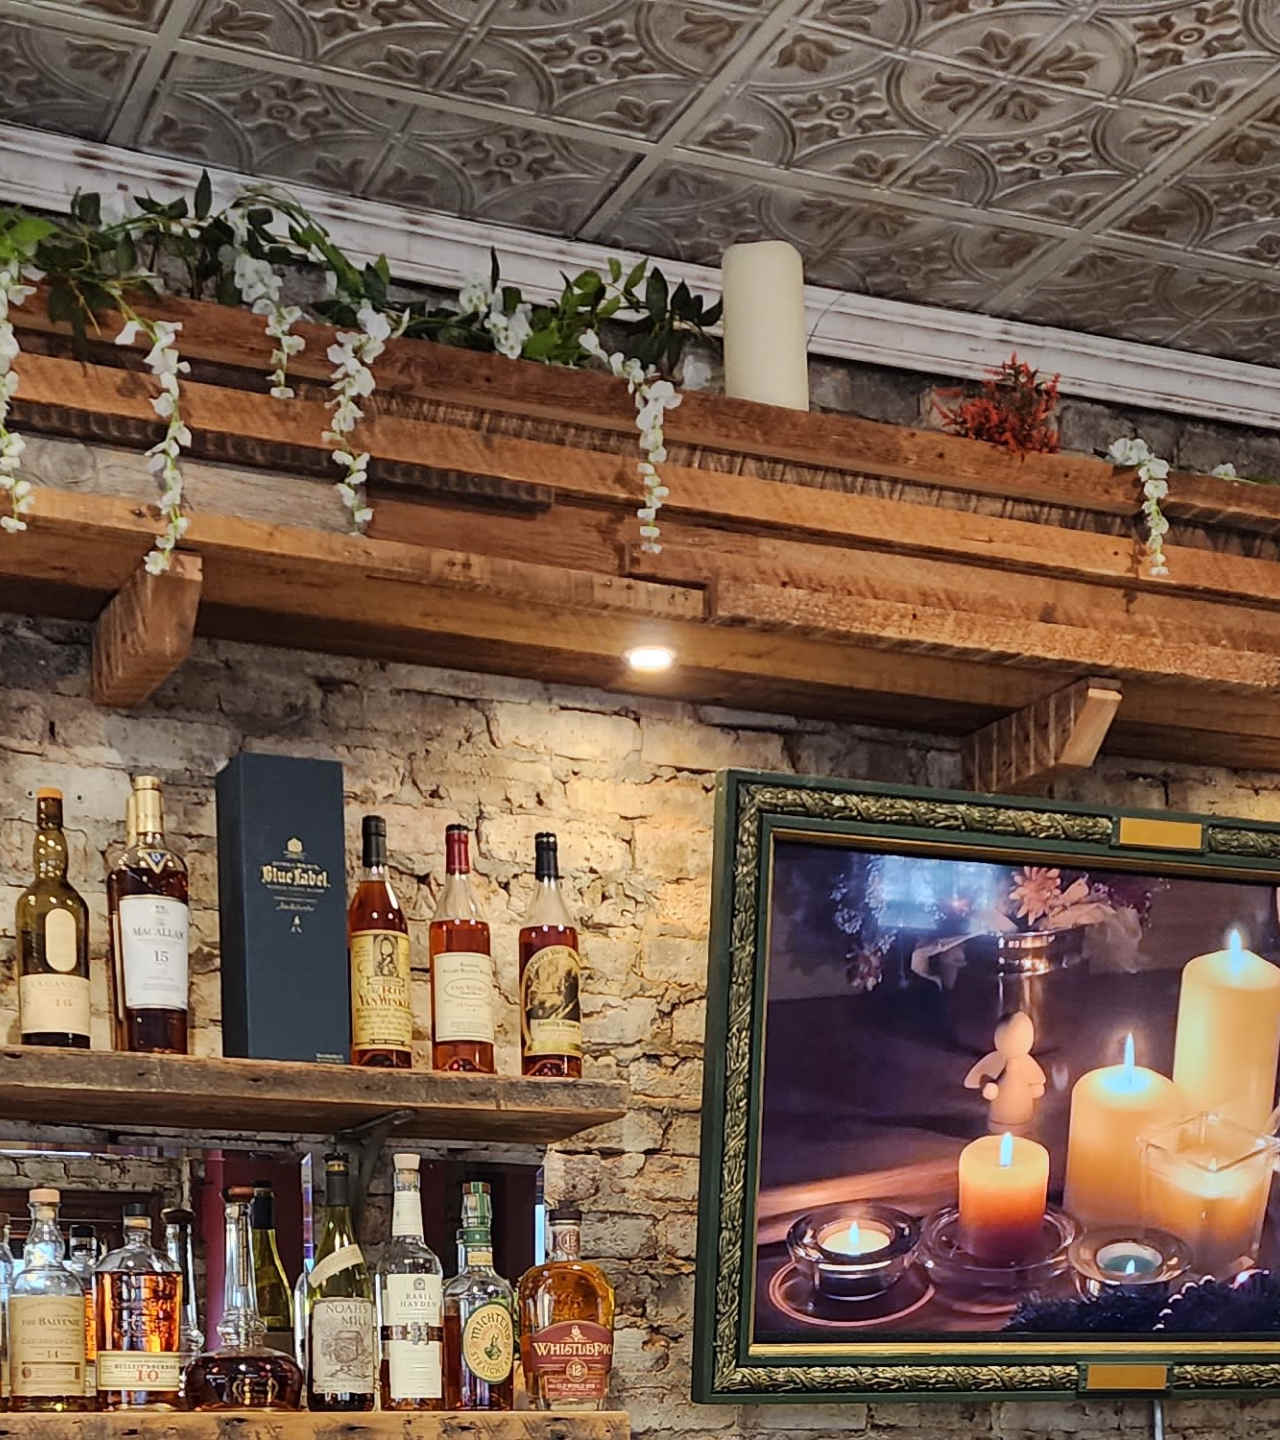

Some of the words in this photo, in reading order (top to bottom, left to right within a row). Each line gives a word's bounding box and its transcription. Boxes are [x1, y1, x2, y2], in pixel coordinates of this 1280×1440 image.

[262, 865, 293, 884] Blue
[294, 868, 328, 887] Label
[154, 950, 168, 962] 15
